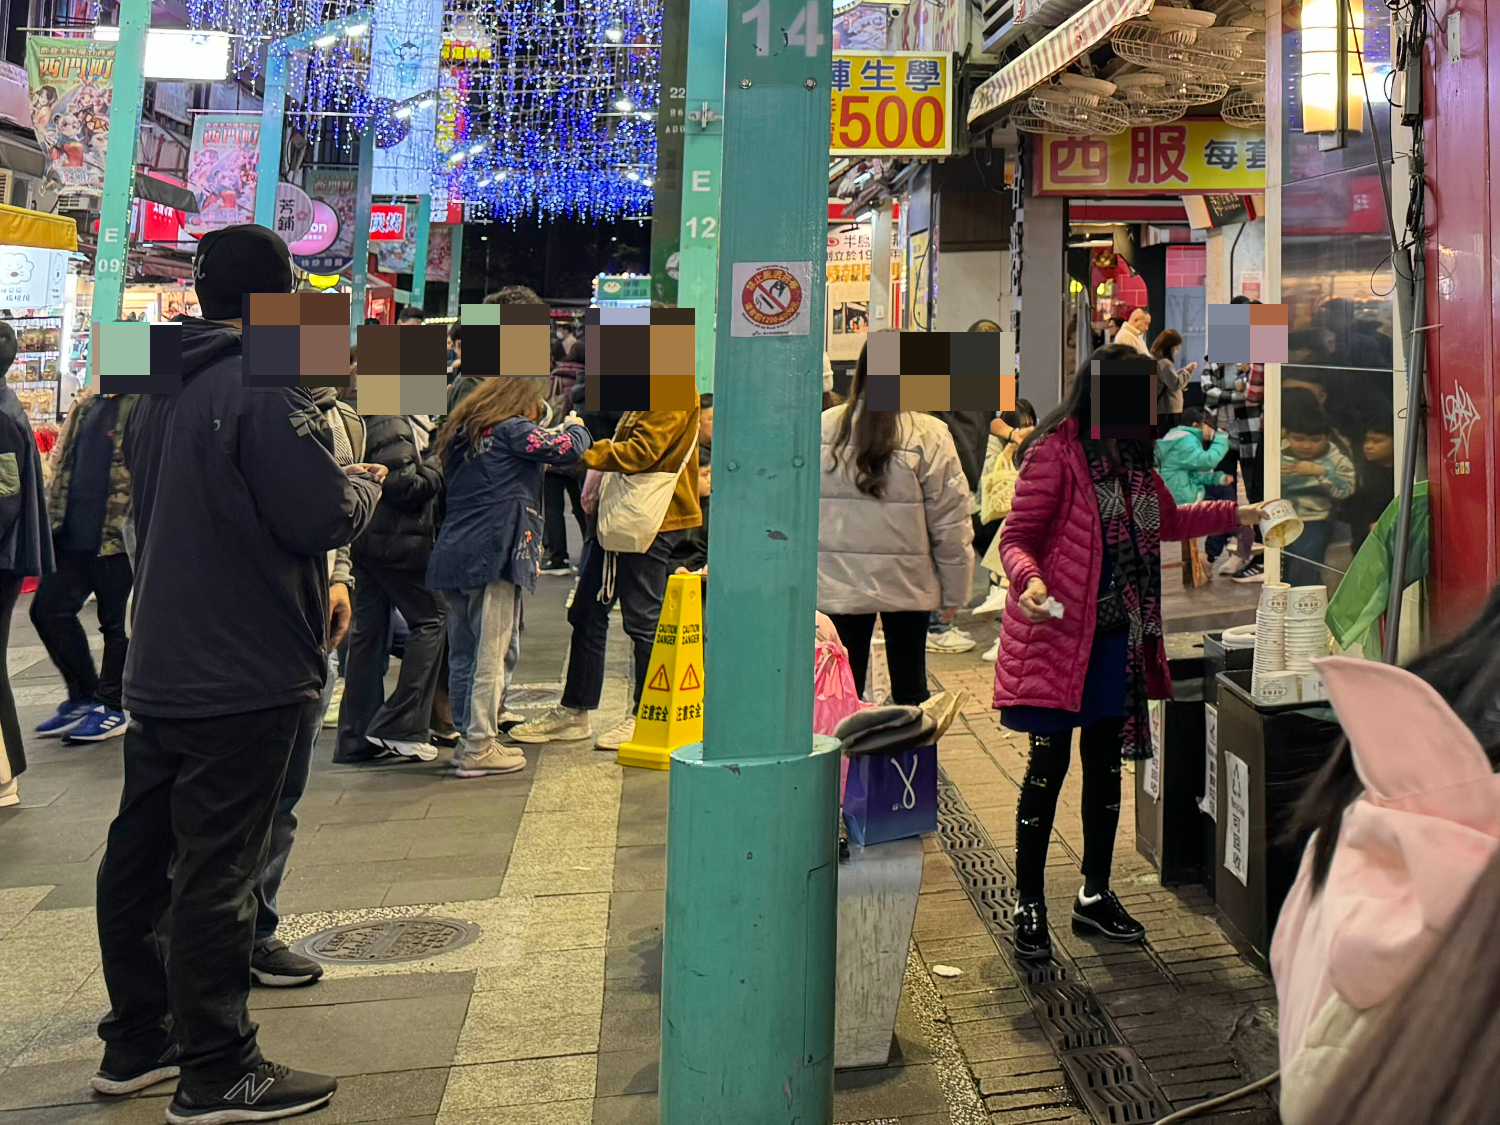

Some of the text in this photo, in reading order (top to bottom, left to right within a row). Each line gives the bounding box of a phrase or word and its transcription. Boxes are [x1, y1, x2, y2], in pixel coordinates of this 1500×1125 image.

[742, 0, 824, 57] 14
[840, 95, 943, 148] 500
[1049, 124, 1190, 184] 西服
[692, 170, 711, 192] E
[104, 227, 119, 243] E
[686, 217, 717, 238] 12
[98, 258, 121, 273] 09
[658, 623, 678, 635] CAUTION
[682, 623, 700, 635] CAUTION
[656, 633, 677, 645] DANGER
[682, 633, 700, 646] DANGER
[641, 703, 669, 722] 注意安全
[676, 702, 701, 722] 注意安全
